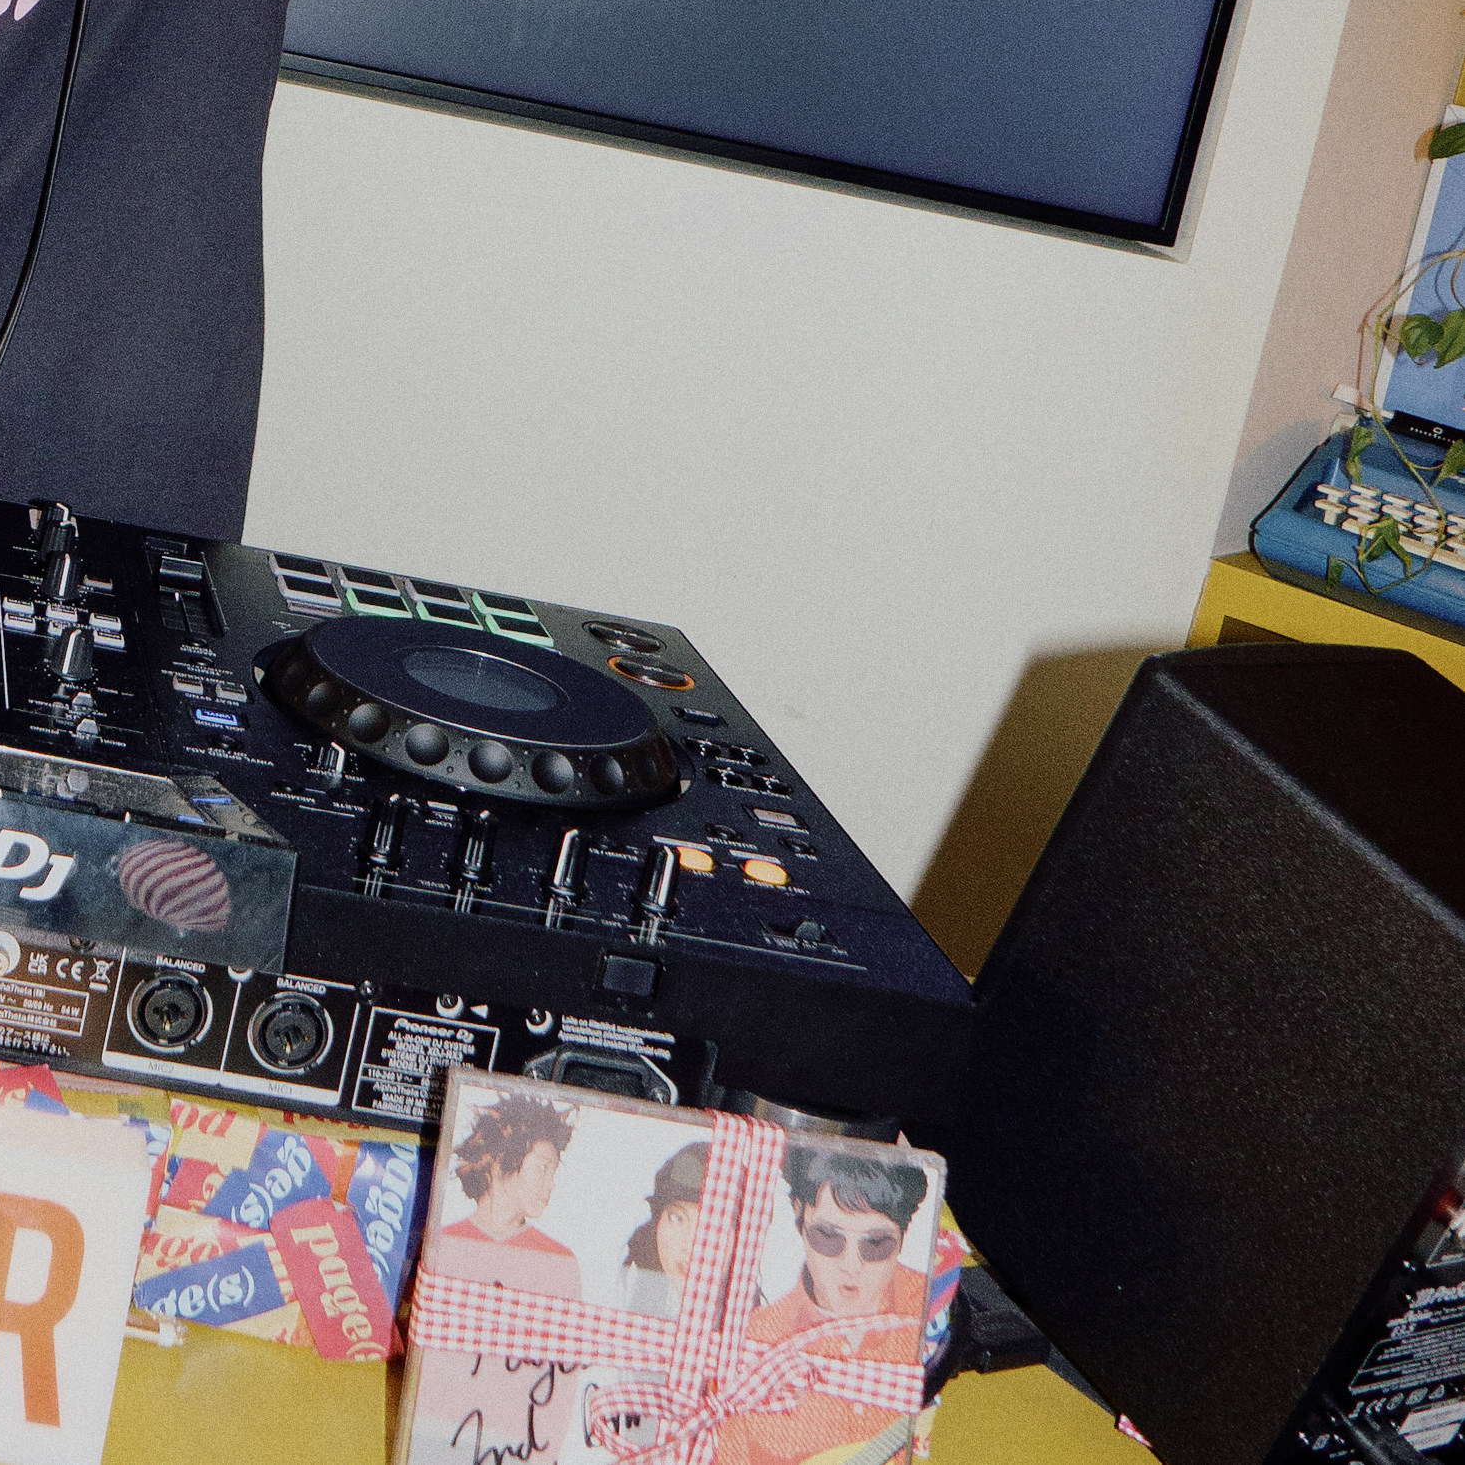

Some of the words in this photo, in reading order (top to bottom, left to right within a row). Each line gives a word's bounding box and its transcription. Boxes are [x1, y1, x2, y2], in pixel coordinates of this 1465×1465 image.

[55, 957, 85, 982] CE
[155, 954, 207, 974] BALANCED
[275, 976, 328, 995] BALANCED
[393, 1017, 456, 1039] Pioneer
[147, 1061, 176, 1074] MIC2
[267, 1084, 294, 1095] MIC1
